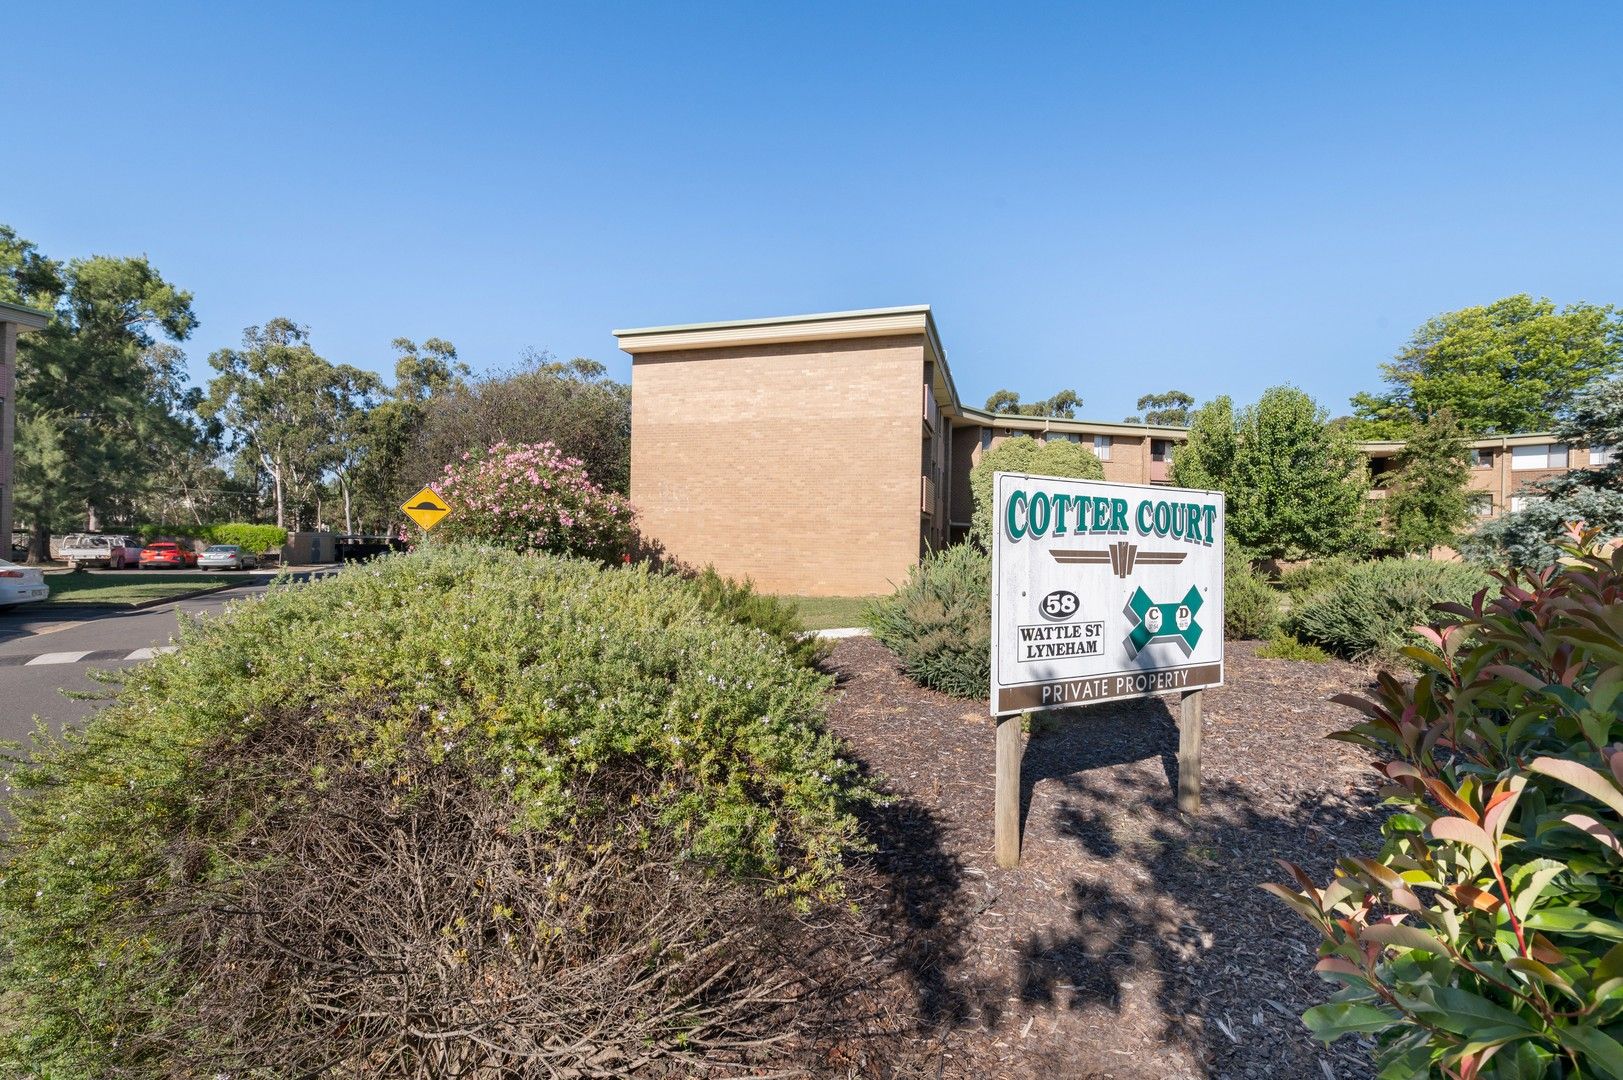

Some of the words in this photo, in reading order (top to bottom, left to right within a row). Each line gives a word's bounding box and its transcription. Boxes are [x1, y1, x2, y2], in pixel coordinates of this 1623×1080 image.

[1006, 489, 1129, 541] COTTER
[1136, 500, 1217, 546] COURT
[1046, 594, 1076, 614] 58
[1179, 607, 1189, 619] D
[1149, 609, 1159, 620] C
[1020, 624, 1081, 642] WATTLE
[1085, 623, 1102, 638] ST
[1026, 641, 1097, 659] LYNEHAM
[1042, 680, 1108, 703] PRIVATE
[1116, 670, 1189, 693] PROPERTY
